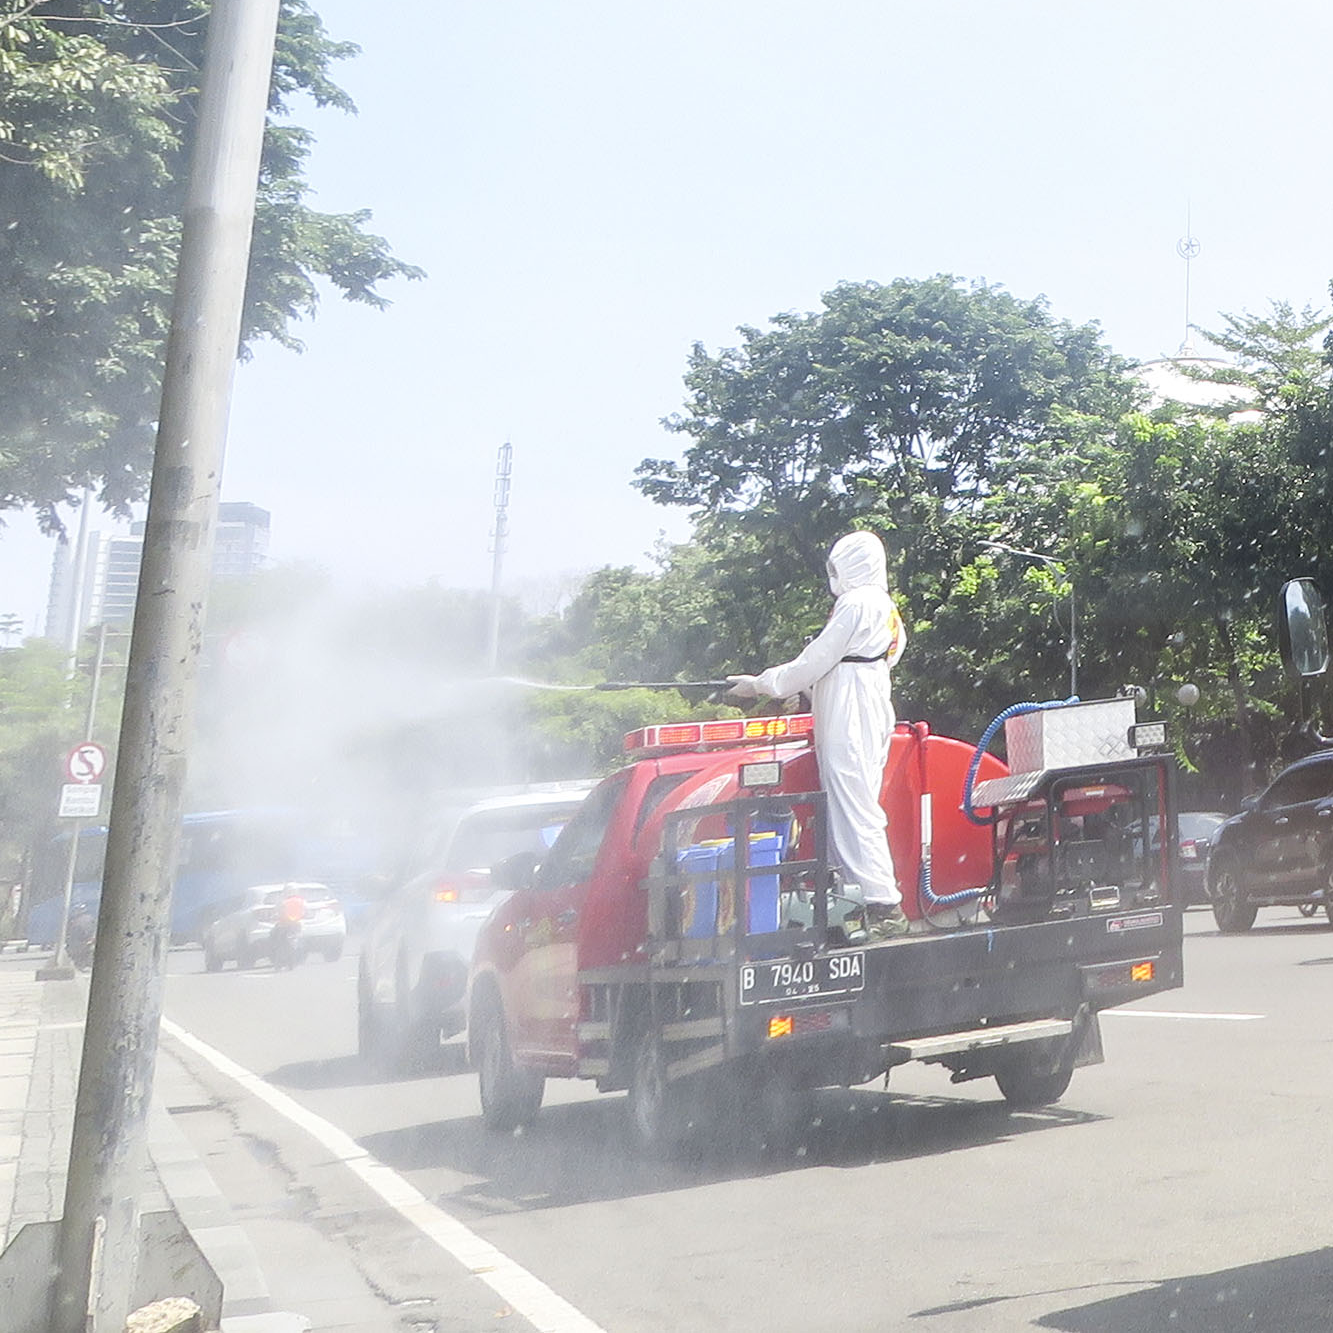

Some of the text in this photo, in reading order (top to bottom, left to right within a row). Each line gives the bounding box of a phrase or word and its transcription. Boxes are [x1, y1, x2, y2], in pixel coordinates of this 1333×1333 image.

[743, 956, 861, 990] B 7940 SDA
